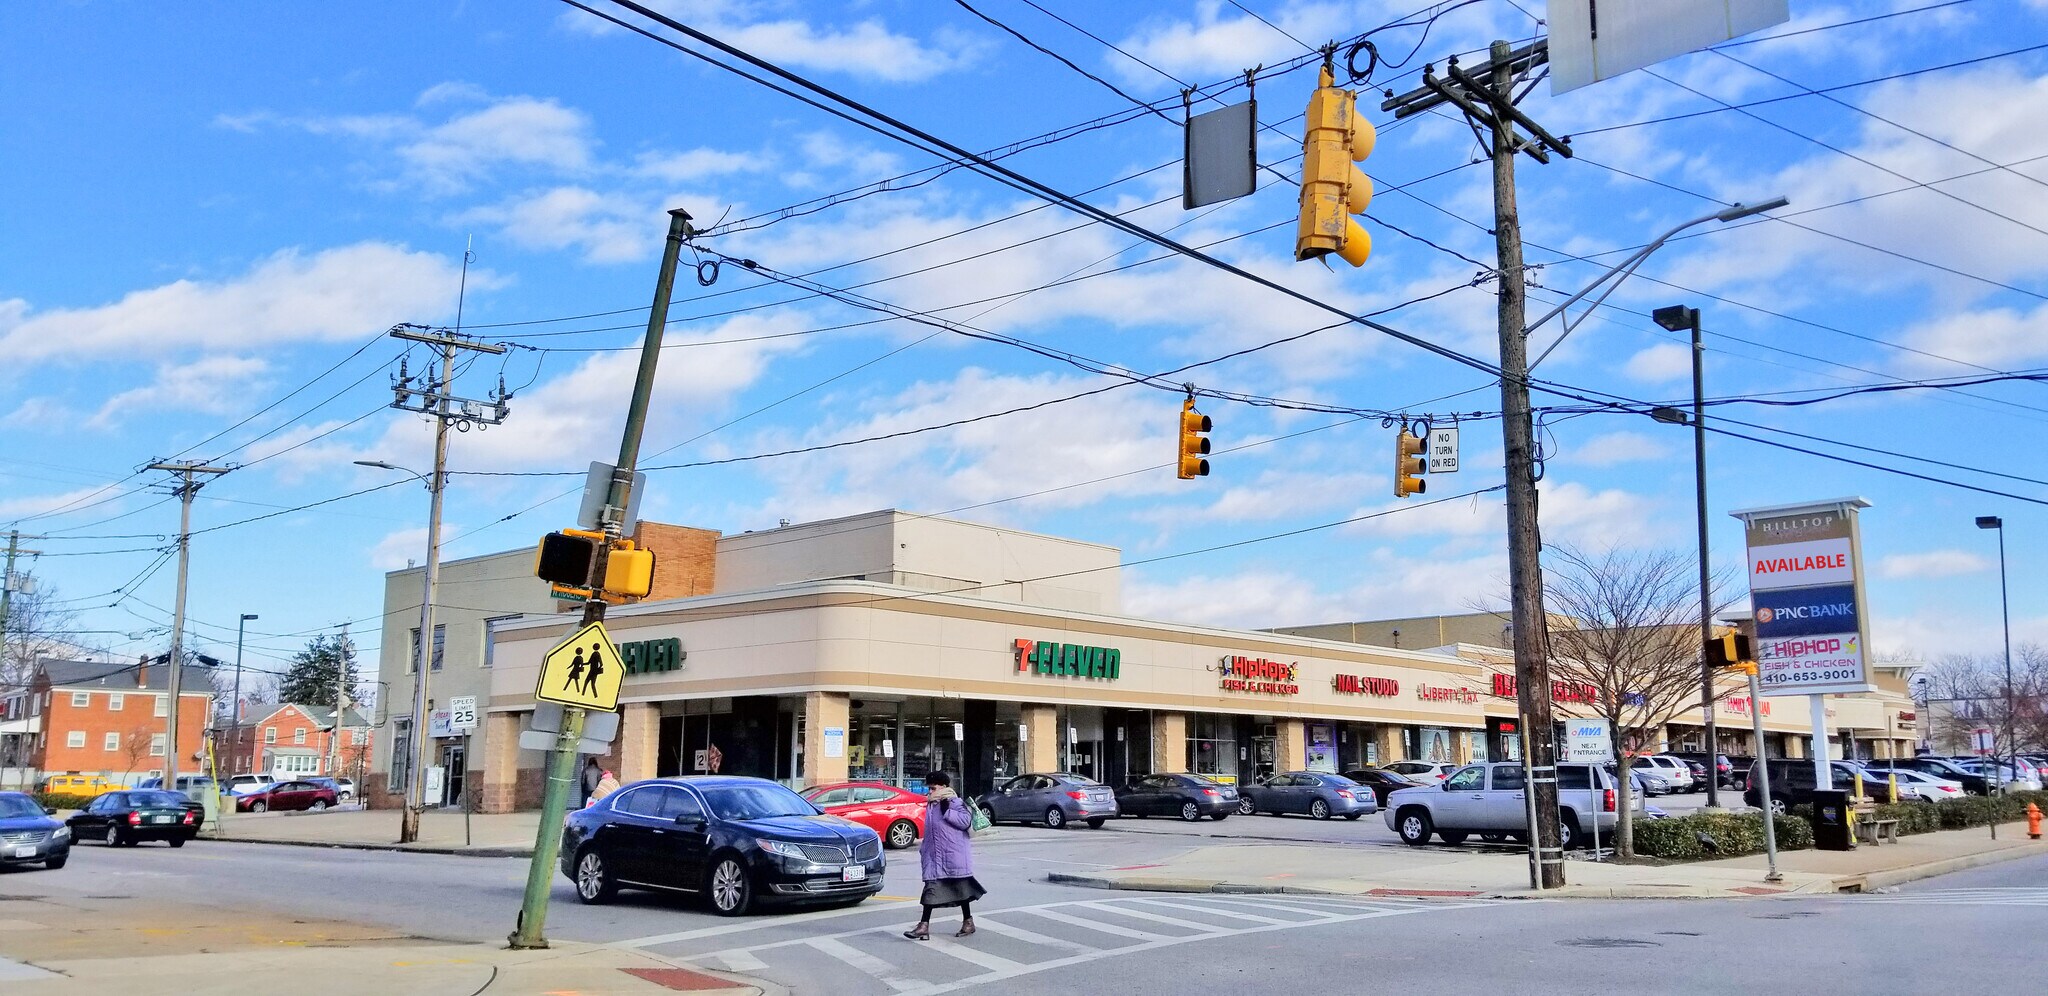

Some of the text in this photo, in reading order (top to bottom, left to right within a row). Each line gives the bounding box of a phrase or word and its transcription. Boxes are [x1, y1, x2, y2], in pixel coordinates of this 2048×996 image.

[1438, 433, 1450, 443] NO
[1435, 446, 1453, 455] TURN
[1431, 458, 1456, 468] ON RED
[1763, 516, 1833, 532] HILLTOP
[1755, 553, 1846, 574] AVAILABLE
[1764, 661, 1790, 671] FISH
[1793, 661, 1801, 669] &
[1765, 669, 1857, 683] 410-653-9001
[1223, 679, 1246, 691] FISH
[1249, 681, 1257, 693] &
[1336, 674, 1400, 696] NAIL STUDIO
[454, 711, 474, 722] 25
[1578, 726, 1602, 736] MVA
